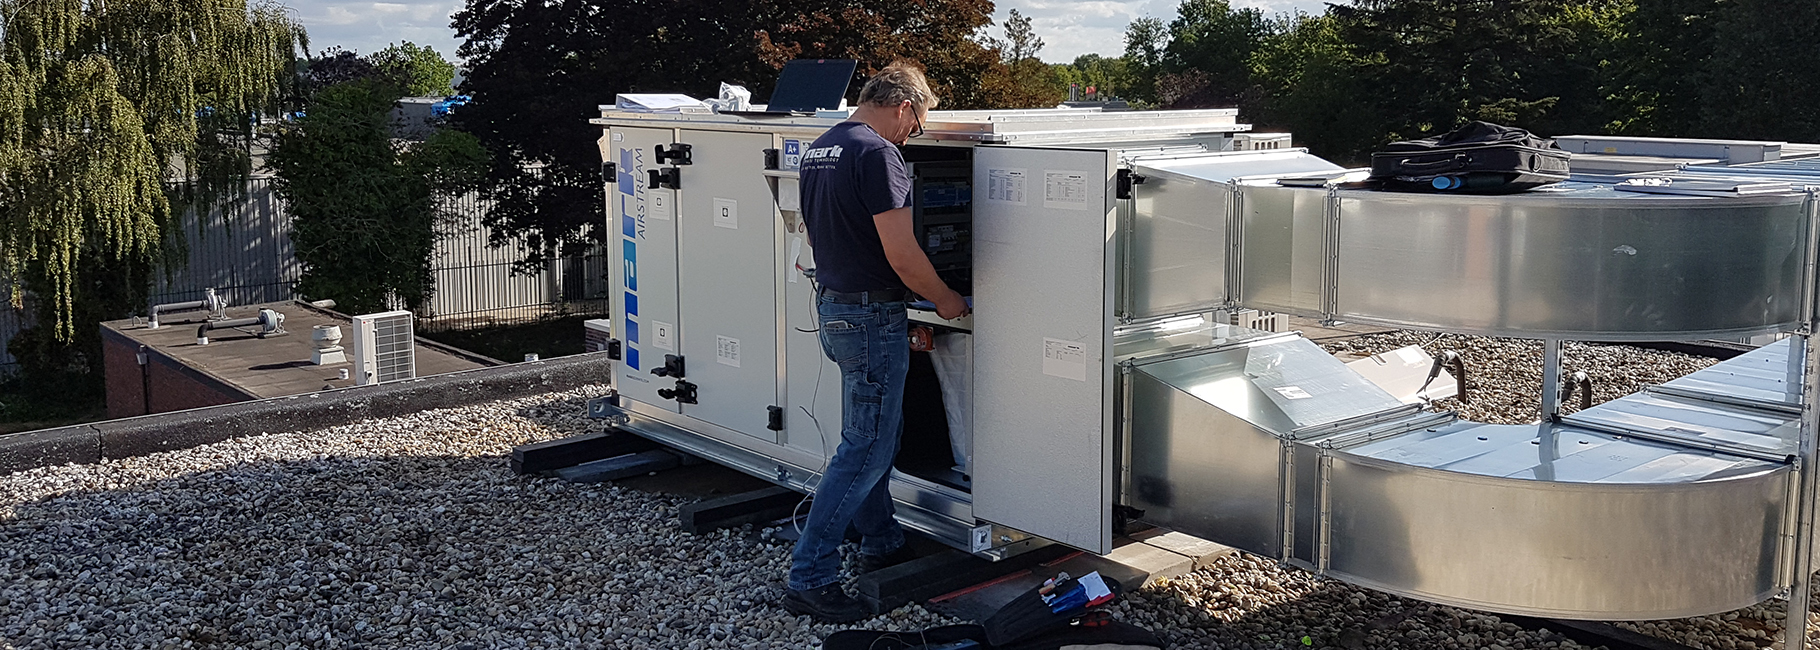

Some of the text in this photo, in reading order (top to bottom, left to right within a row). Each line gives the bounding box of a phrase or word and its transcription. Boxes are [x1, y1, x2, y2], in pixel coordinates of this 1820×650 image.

[635, 148, 646, 240] AIRSTREAM
[788, 144, 796, 154] A+
[618, 148, 640, 371] mark
